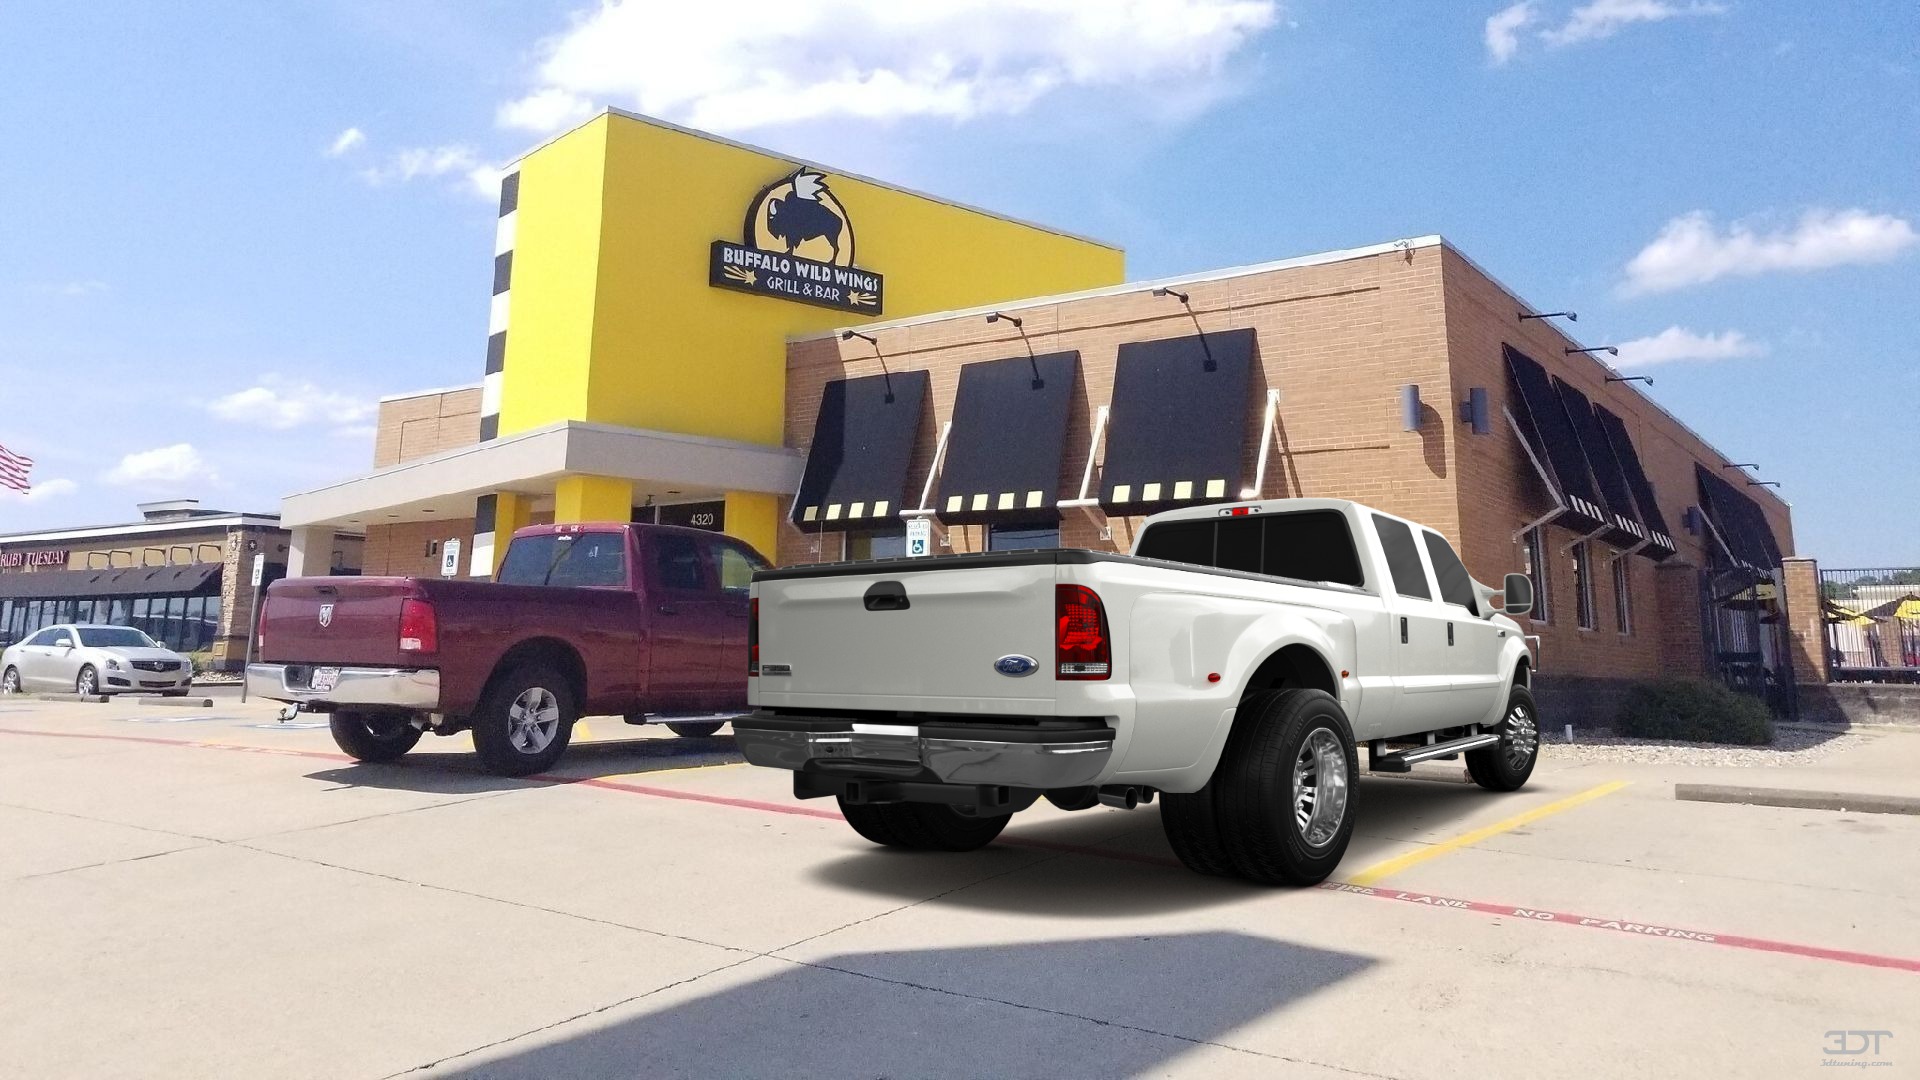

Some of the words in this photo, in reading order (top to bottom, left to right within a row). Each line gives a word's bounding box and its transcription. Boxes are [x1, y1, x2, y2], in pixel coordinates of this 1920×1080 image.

[724, 247, 790, 273] BUFFALO
[795, 261, 831, 281] WILD
[835, 269, 877, 291] WINGS
[767, 276, 800, 294] GRILL
[802, 282, 812, 296] &
[815, 284, 840, 301] BAR
[690, 513, 714, 525] 4320
[0, 553, 22, 566] RUBY
[27, 550, 66, 566] TUESDAY
[1002, 659, 1025, 671] Ford
[1320, 883, 1375, 895] FIRE
[1396, 893, 1471, 908] LANE
[1513, 908, 1555, 920] NO
[1580, 918, 1715, 942] PARKING
